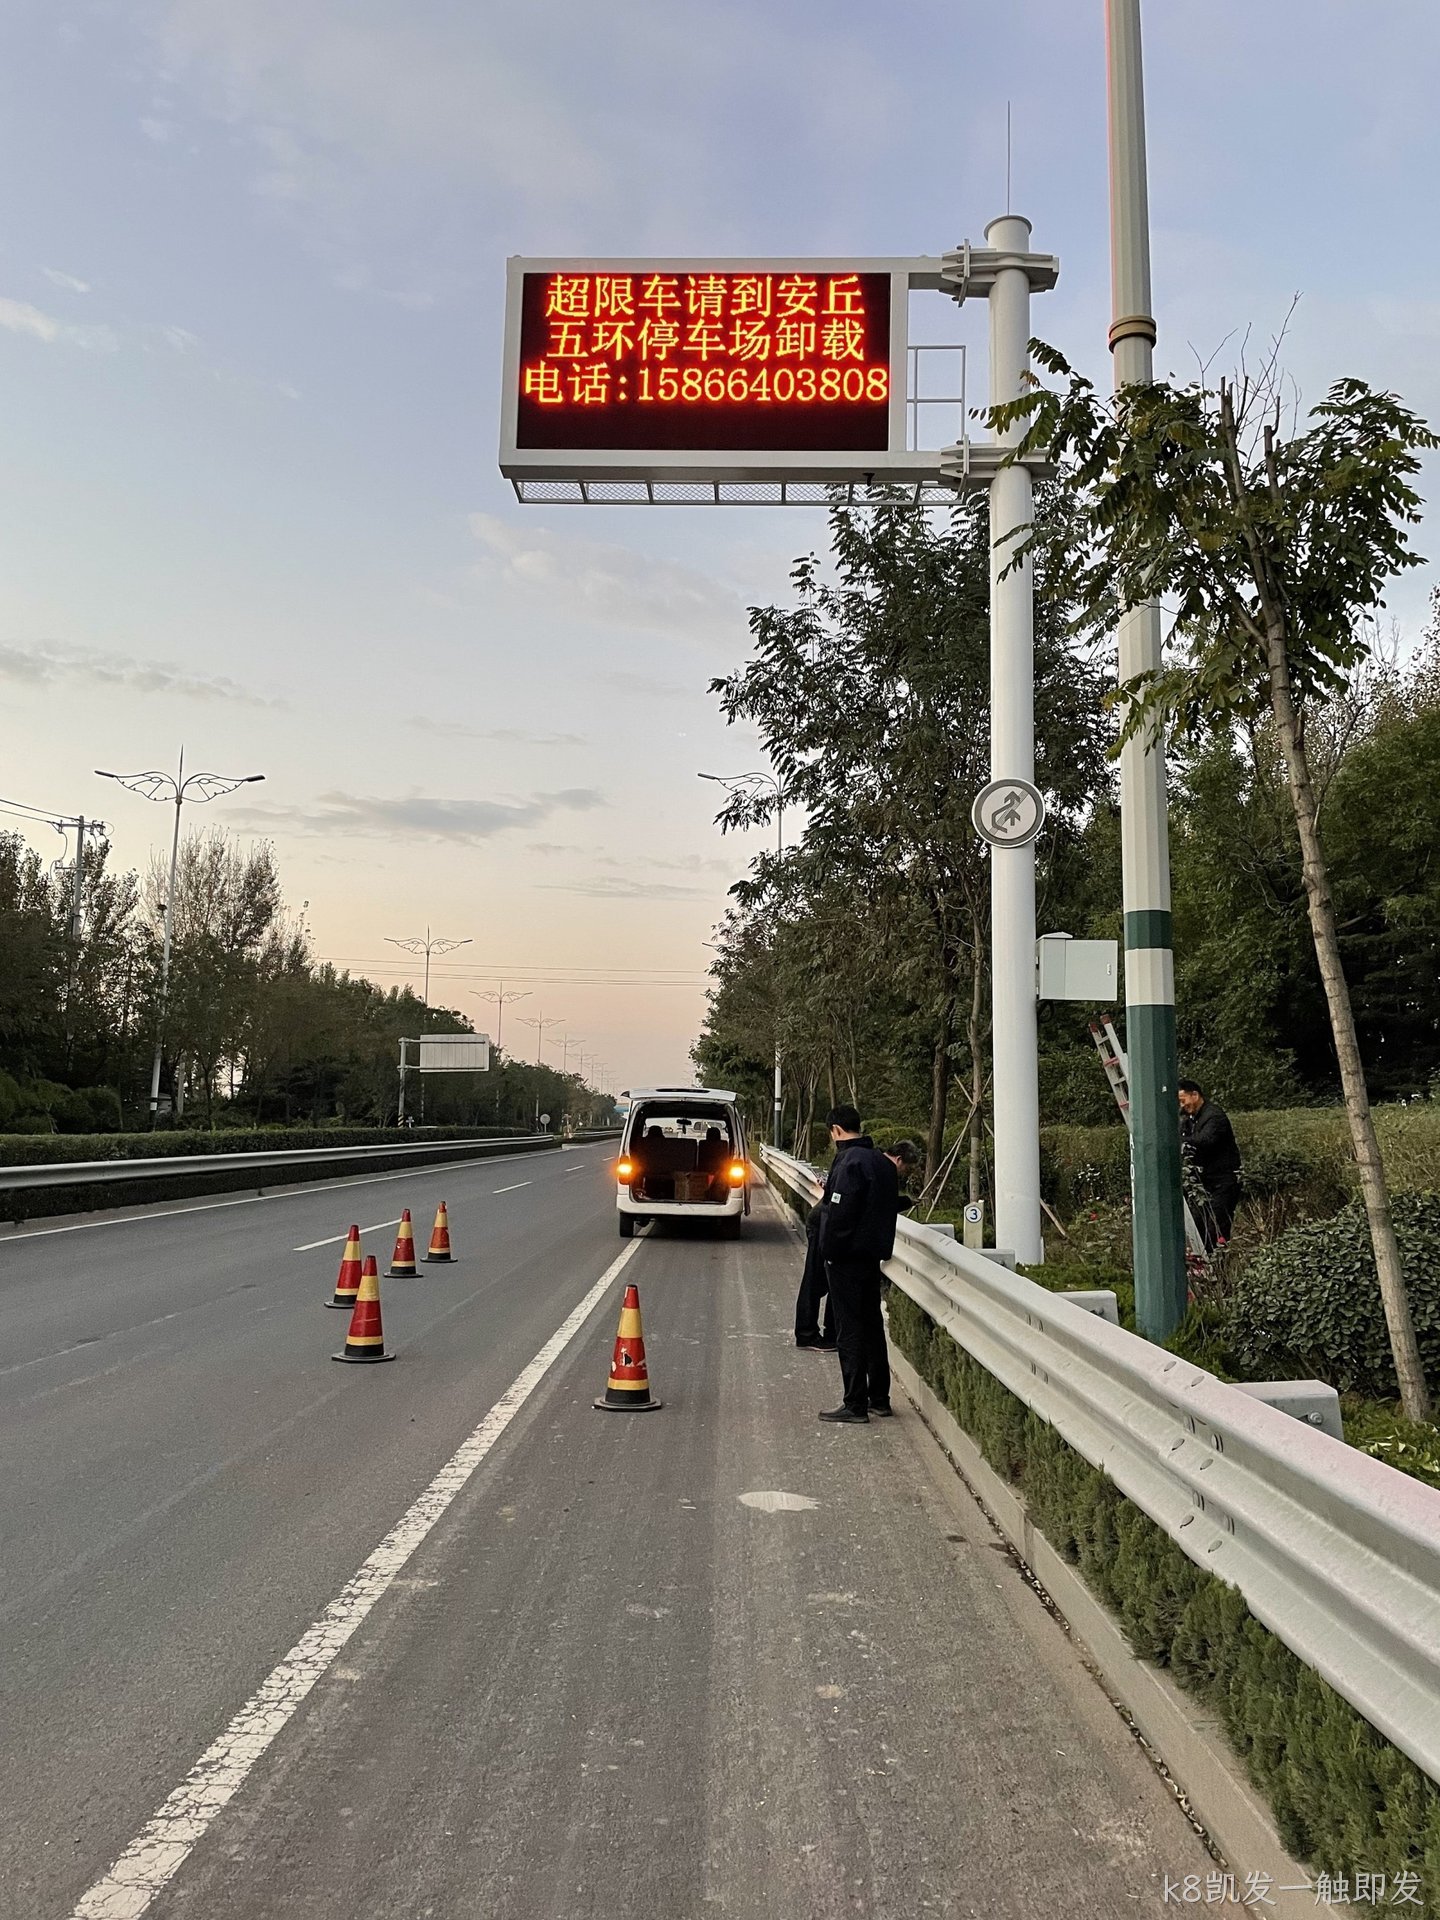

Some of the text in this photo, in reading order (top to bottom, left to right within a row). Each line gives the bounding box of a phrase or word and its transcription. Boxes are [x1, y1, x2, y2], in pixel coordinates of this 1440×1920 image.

[545, 273, 865, 317] 超限车请到安丘
[546, 318, 865, 361] 五环停车场卸载
[970, 1208, 978, 1220] 3
